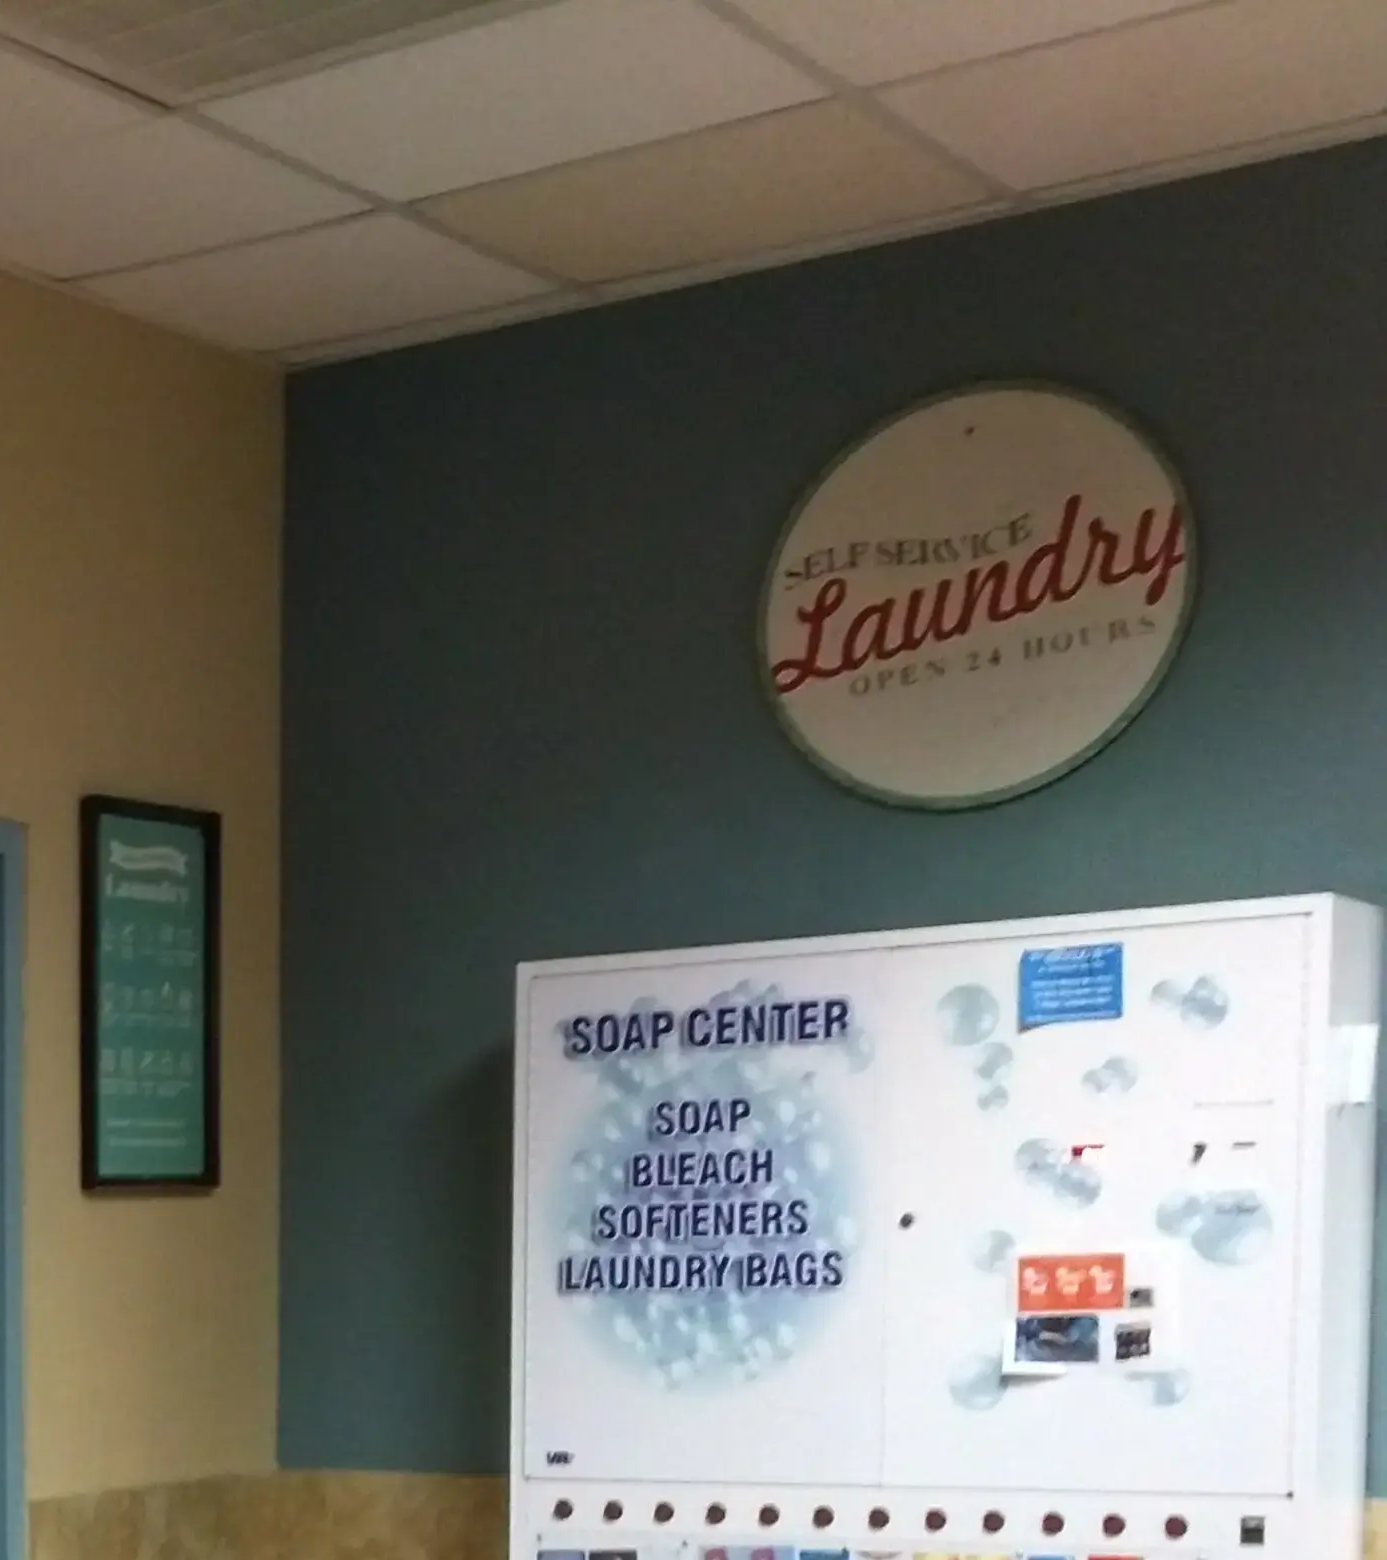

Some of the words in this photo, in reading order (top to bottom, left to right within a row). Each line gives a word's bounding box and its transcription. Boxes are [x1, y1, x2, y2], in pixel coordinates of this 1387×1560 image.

[783, 540, 873, 591] SELF
[874, 512, 1035, 567] SERVICE
[770, 493, 1187, 694] Laundry
[848, 658, 947, 698] OPEN
[965, 652, 1003, 673] 24
[1023, 616, 1157, 662] HOURS
[569, 1010, 674, 1056] SOAP
[687, 999, 851, 1048] CENTER
[654, 1098, 752, 1137] SOAP
[632, 1149, 774, 1188] BLEACH
[596, 1199, 809, 1240] SOFTENERS
[562, 1252, 731, 1292] LAUNDRY
[744, 1250, 845, 1288] BAGS
